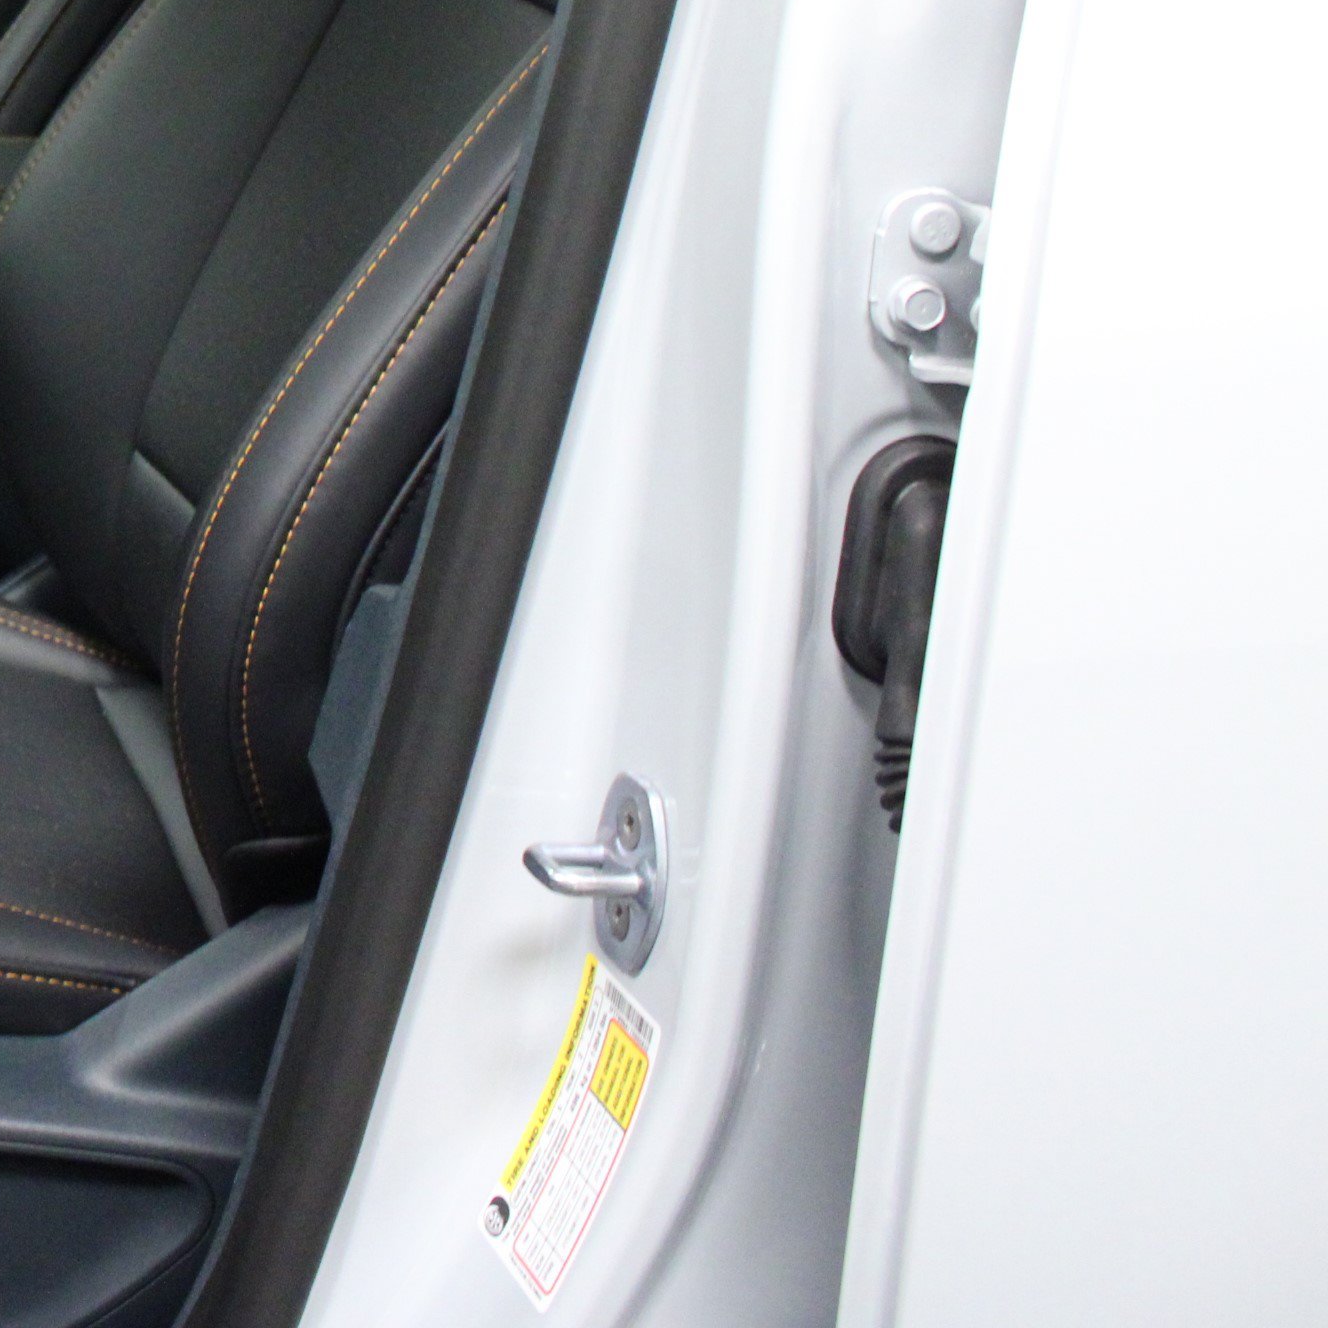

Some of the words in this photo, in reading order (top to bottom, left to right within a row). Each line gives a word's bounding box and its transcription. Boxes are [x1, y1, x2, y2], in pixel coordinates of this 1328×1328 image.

[506, 1156, 524, 1186] TIRE
[523, 1124, 539, 1155] AND
[537, 1061, 566, 1125] LOADING
[564, 964, 595, 1061] INFORMATION
